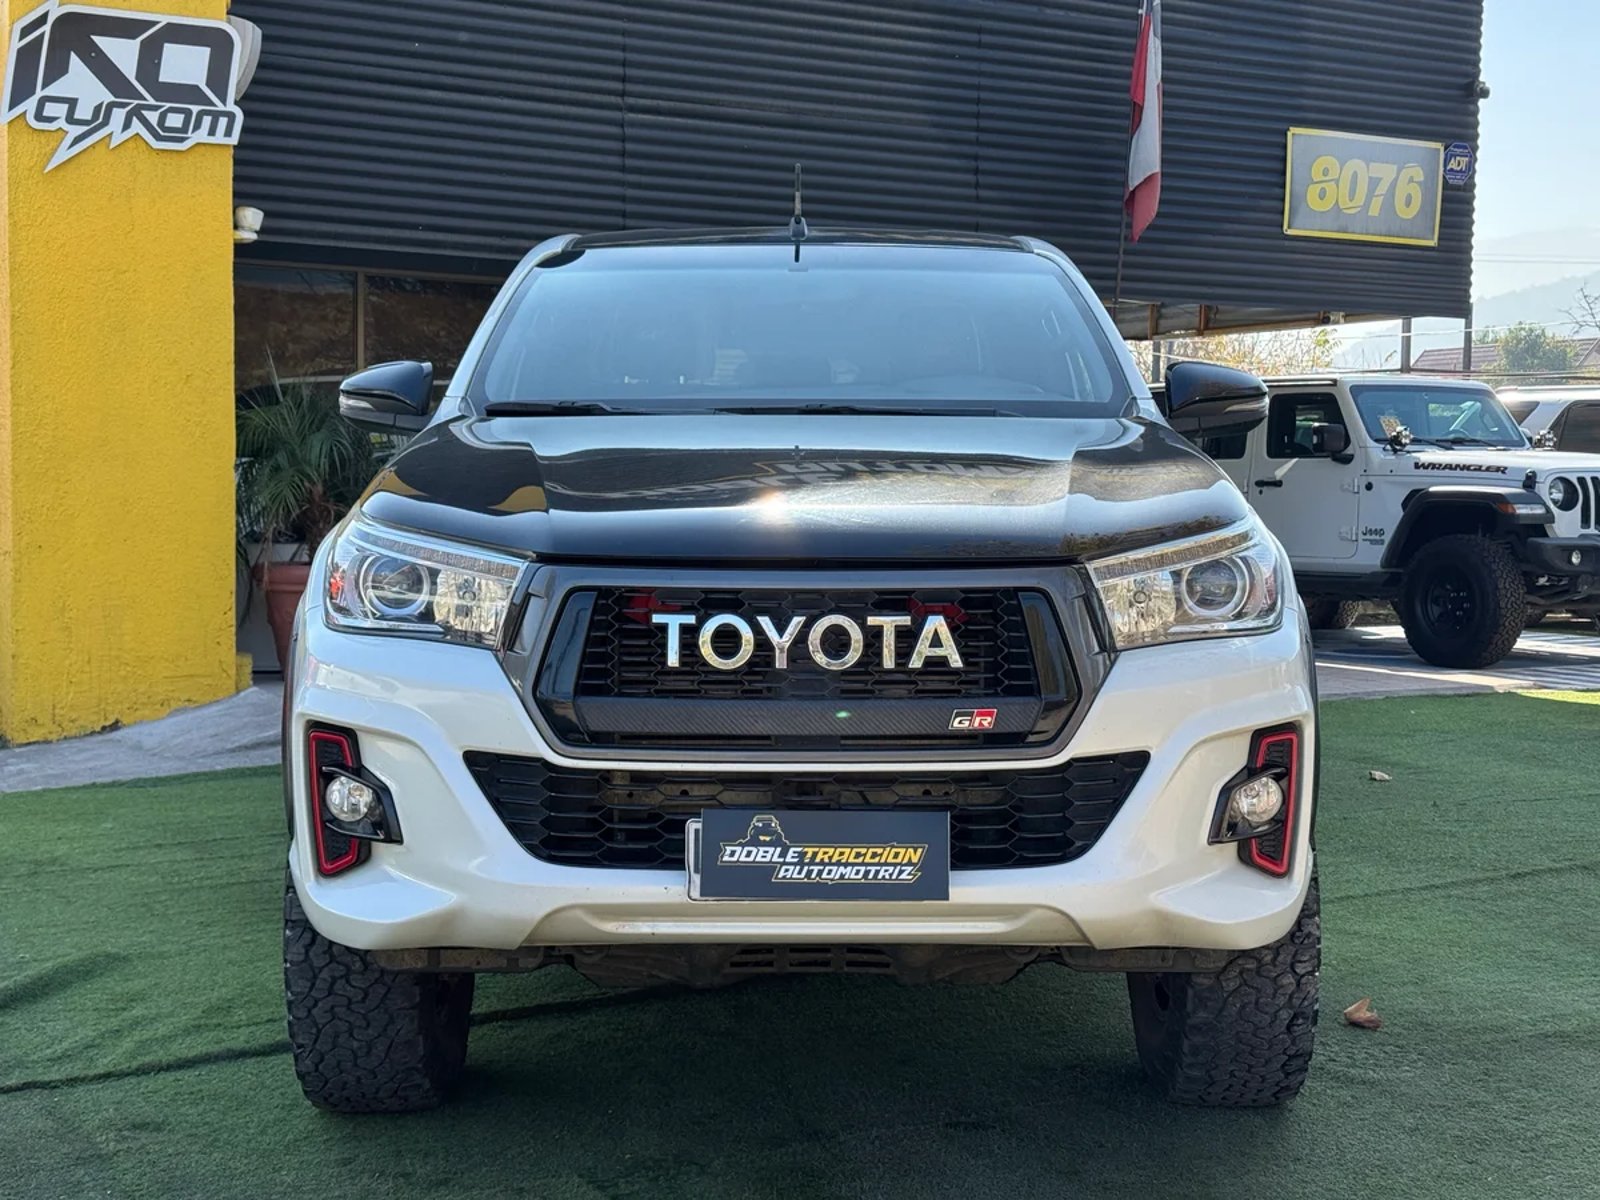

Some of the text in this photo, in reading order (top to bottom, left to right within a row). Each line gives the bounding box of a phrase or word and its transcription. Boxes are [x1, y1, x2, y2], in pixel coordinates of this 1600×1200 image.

[1447, 156, 1469, 172] ADT
[1307, 155, 1424, 220] 8076
[1414, 461, 1508, 475] WRANGLER
[1361, 526, 1385, 538] Jeep
[652, 613, 964, 670] TOYOTA
[952, 716, 993, 728] GR
[777, 865, 915, 880] AUTOMOTRIZ
